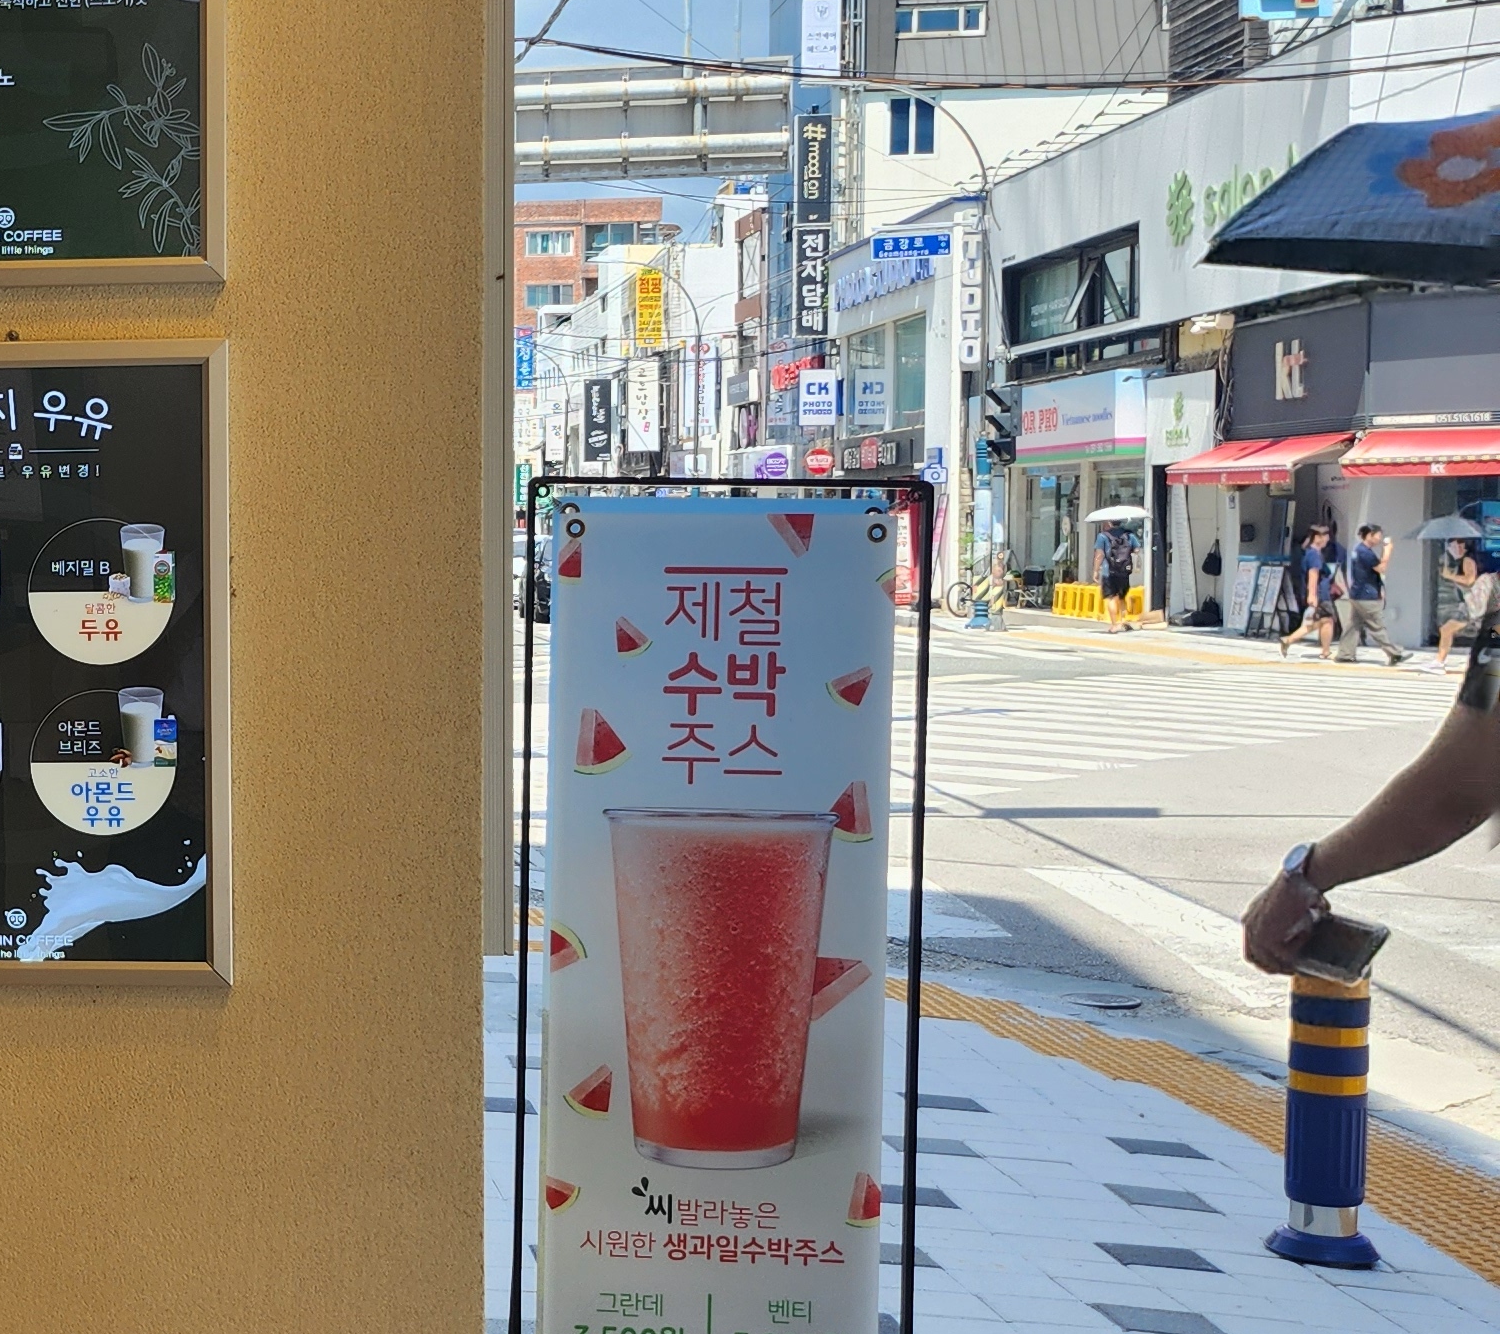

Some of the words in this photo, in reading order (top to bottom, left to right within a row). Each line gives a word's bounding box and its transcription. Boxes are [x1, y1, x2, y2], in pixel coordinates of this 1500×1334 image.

[3, 229, 63, 242] COFFEE
[882, 238, 925, 251] 금강로
[24, 244, 54, 257] things
[801, 232, 824, 333] 전자담배
[805, 381, 830, 396] CK
[802, 400, 833, 408] PHOTO
[33, 390, 113, 441] 우유
[21, 464, 100, 478] 우유변경!
[51, 560, 96, 577] 베지밀
[100, 561, 110, 575] B
[665, 580, 781, 647] 제철
[78, 618, 123, 642] 두유
[663, 651, 787, 717] 수박
[58, 721, 102, 737] 아몬드
[58, 740, 102, 756] 브리즈
[662, 723, 782, 785] 주스
[87, 767, 119, 779] 고소한
[71, 781, 136, 803] 아몬드
[82, 806, 125, 827] 우유
[579, 1229, 656, 1260] 시원한
[662, 1233, 845, 1266] 생과일수박주스
[596, 1293, 664, 1317] 그란데
[768, 1298, 813, 1324] 벤티
